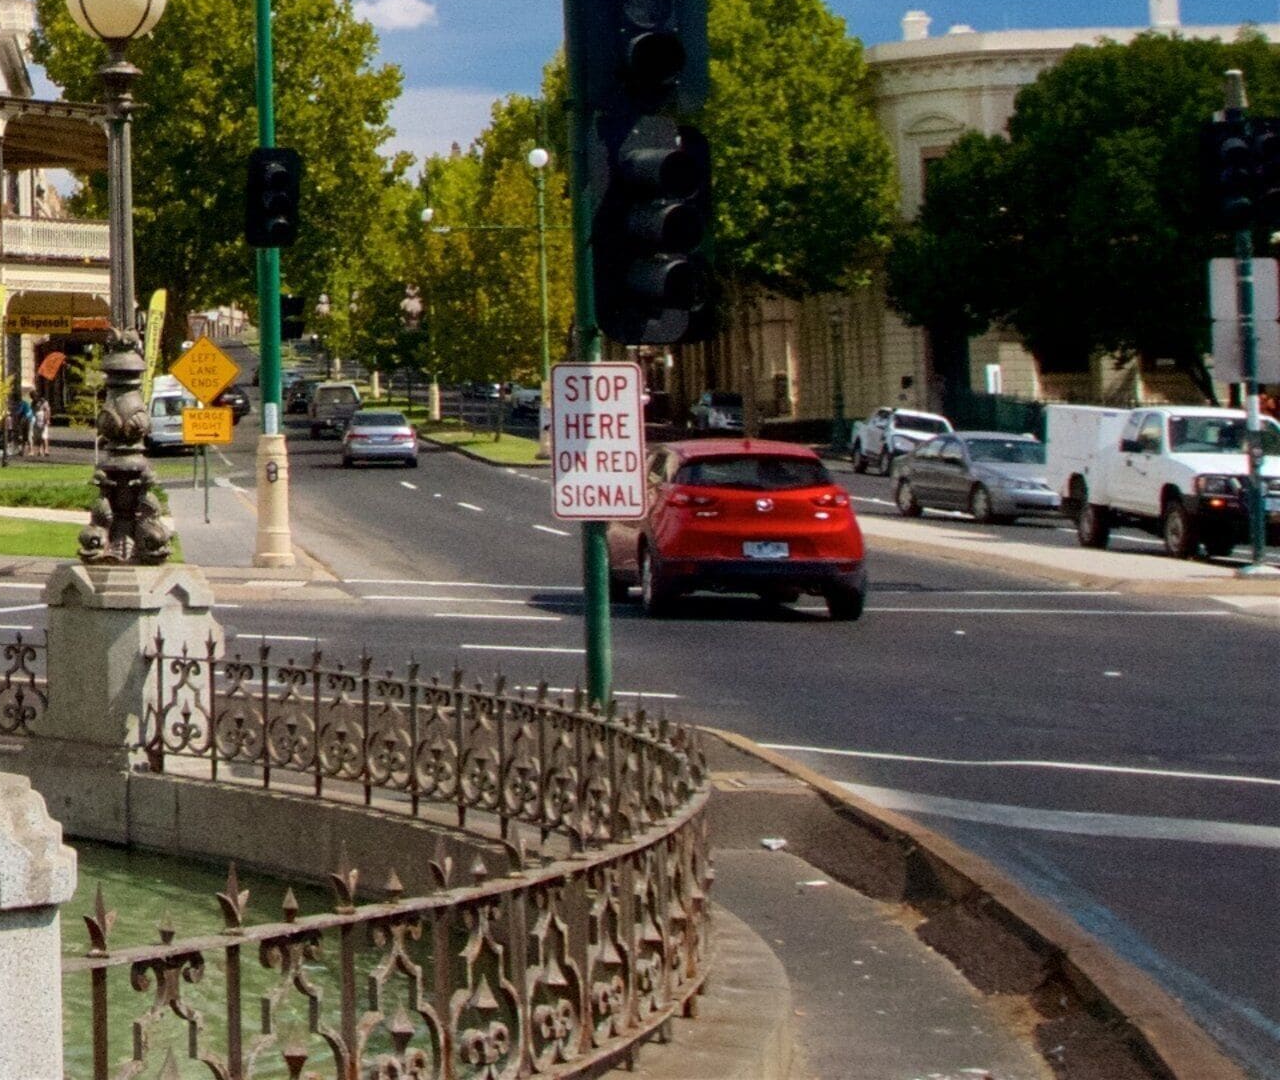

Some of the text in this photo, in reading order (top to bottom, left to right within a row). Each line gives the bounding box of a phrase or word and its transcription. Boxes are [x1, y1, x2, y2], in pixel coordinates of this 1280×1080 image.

[20, 316, 69, 329] Disposals
[191, 353, 216, 363] LEFT
[190, 366, 218, 376] LANE
[191, 378, 219, 388] ENDS
[564, 375, 627, 402] STOP
[189, 411, 224, 420] MERGE
[192, 422, 221, 431] RIGHT
[565, 413, 630, 439] HERE
[559, 450, 637, 473] ON RED
[561, 484, 641, 508] SIGNAL
